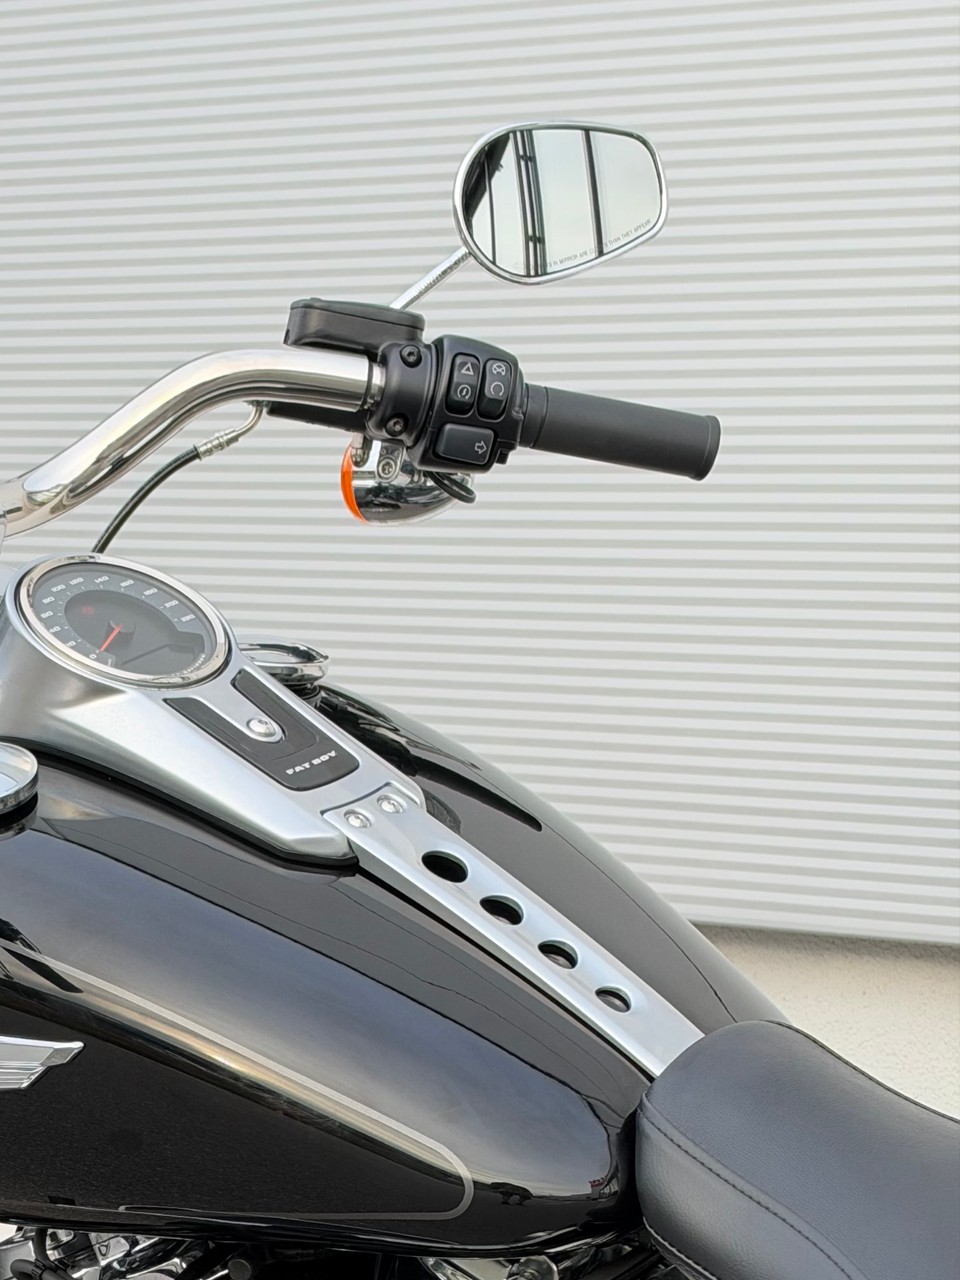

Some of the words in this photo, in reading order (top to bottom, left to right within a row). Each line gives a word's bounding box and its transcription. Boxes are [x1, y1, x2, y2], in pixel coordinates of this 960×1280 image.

[94, 575, 109, 584] 140
[285, 761, 311, 775] FAT
[311, 750, 337, 766] BOY
